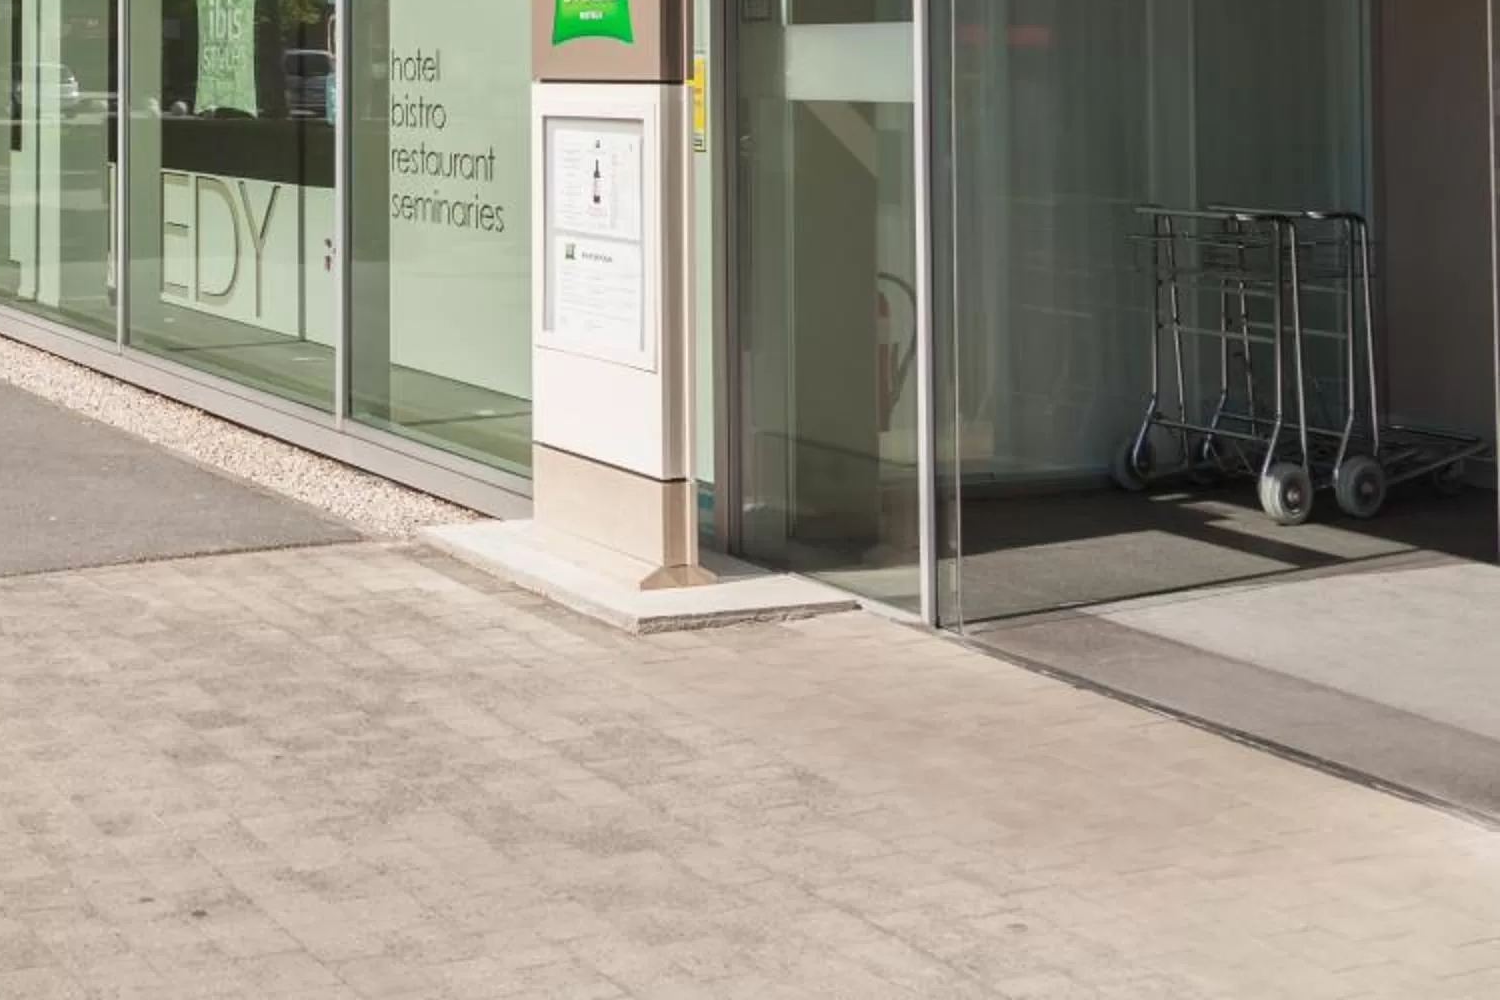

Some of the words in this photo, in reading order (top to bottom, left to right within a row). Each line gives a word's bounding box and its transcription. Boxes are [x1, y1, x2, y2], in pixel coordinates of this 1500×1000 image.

[391, 48, 441, 82] hotel
[391, 93, 447, 129] bistro
[391, 142, 496, 182] restaurant
[391, 189, 505, 232] seminaries
